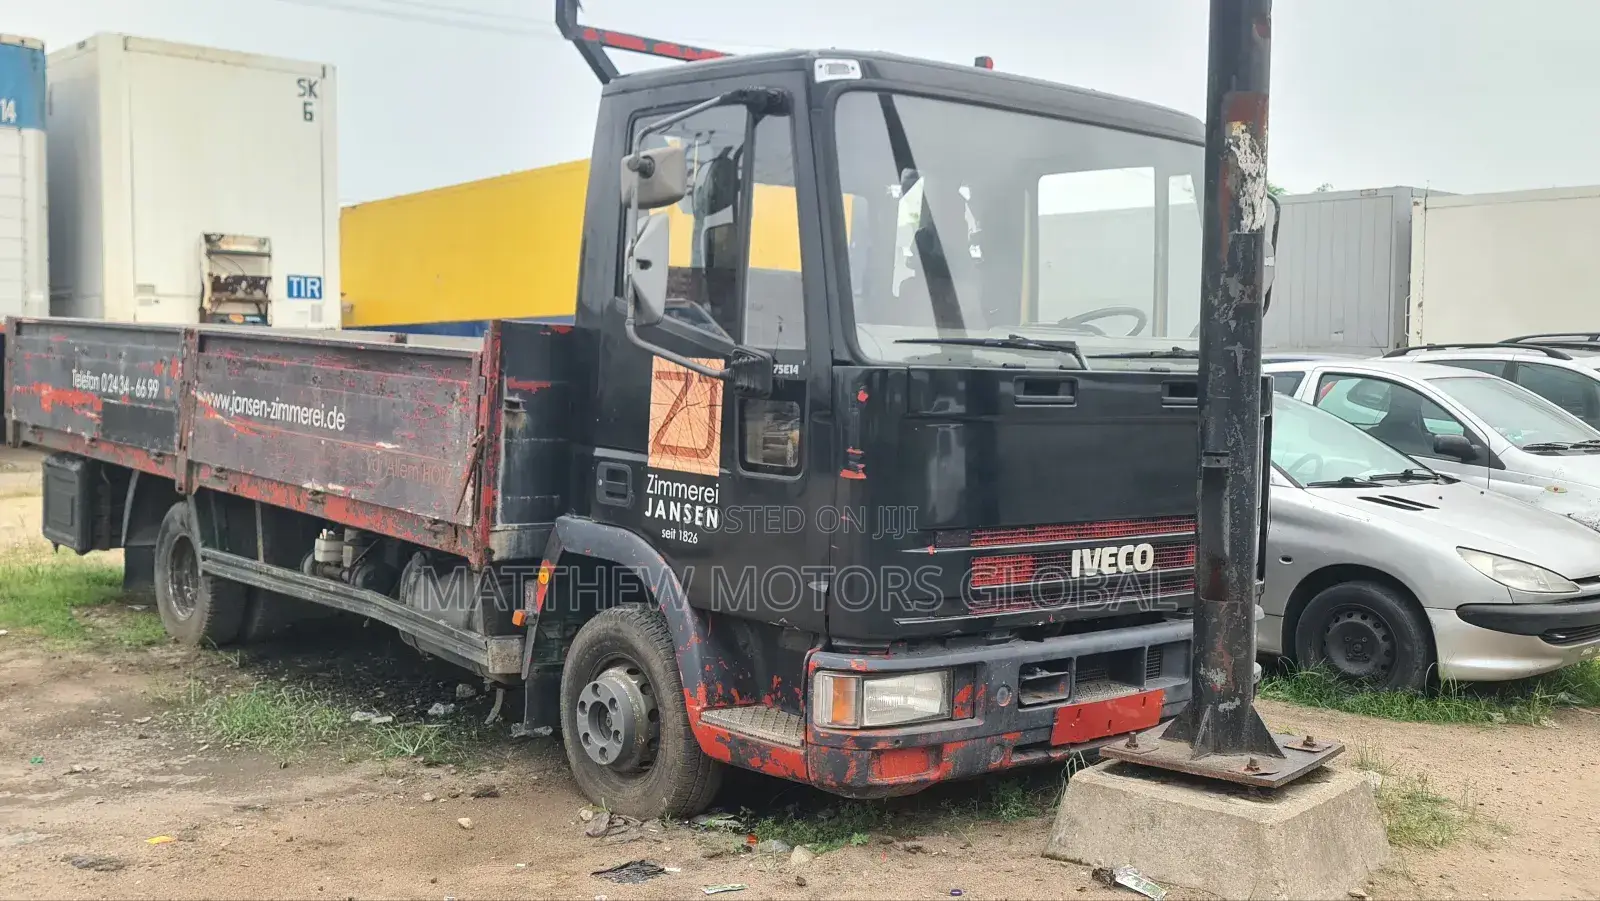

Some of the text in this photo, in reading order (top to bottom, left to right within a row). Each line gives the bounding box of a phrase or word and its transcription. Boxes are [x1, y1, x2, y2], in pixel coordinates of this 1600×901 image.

[297, 78, 318, 98] SK
[303, 102, 314, 122] 6
[289, 277, 320, 299] TIR
[773, 364, 799, 375] 75E14
[202, 389, 346, 431] www.jansen-zimmerei.de
[646, 473, 720, 504] Zimmerei
[644, 497, 719, 529] JANSEN
[661, 527, 698, 544] seit 1826
[1071, 543, 1154, 578] IVECO
